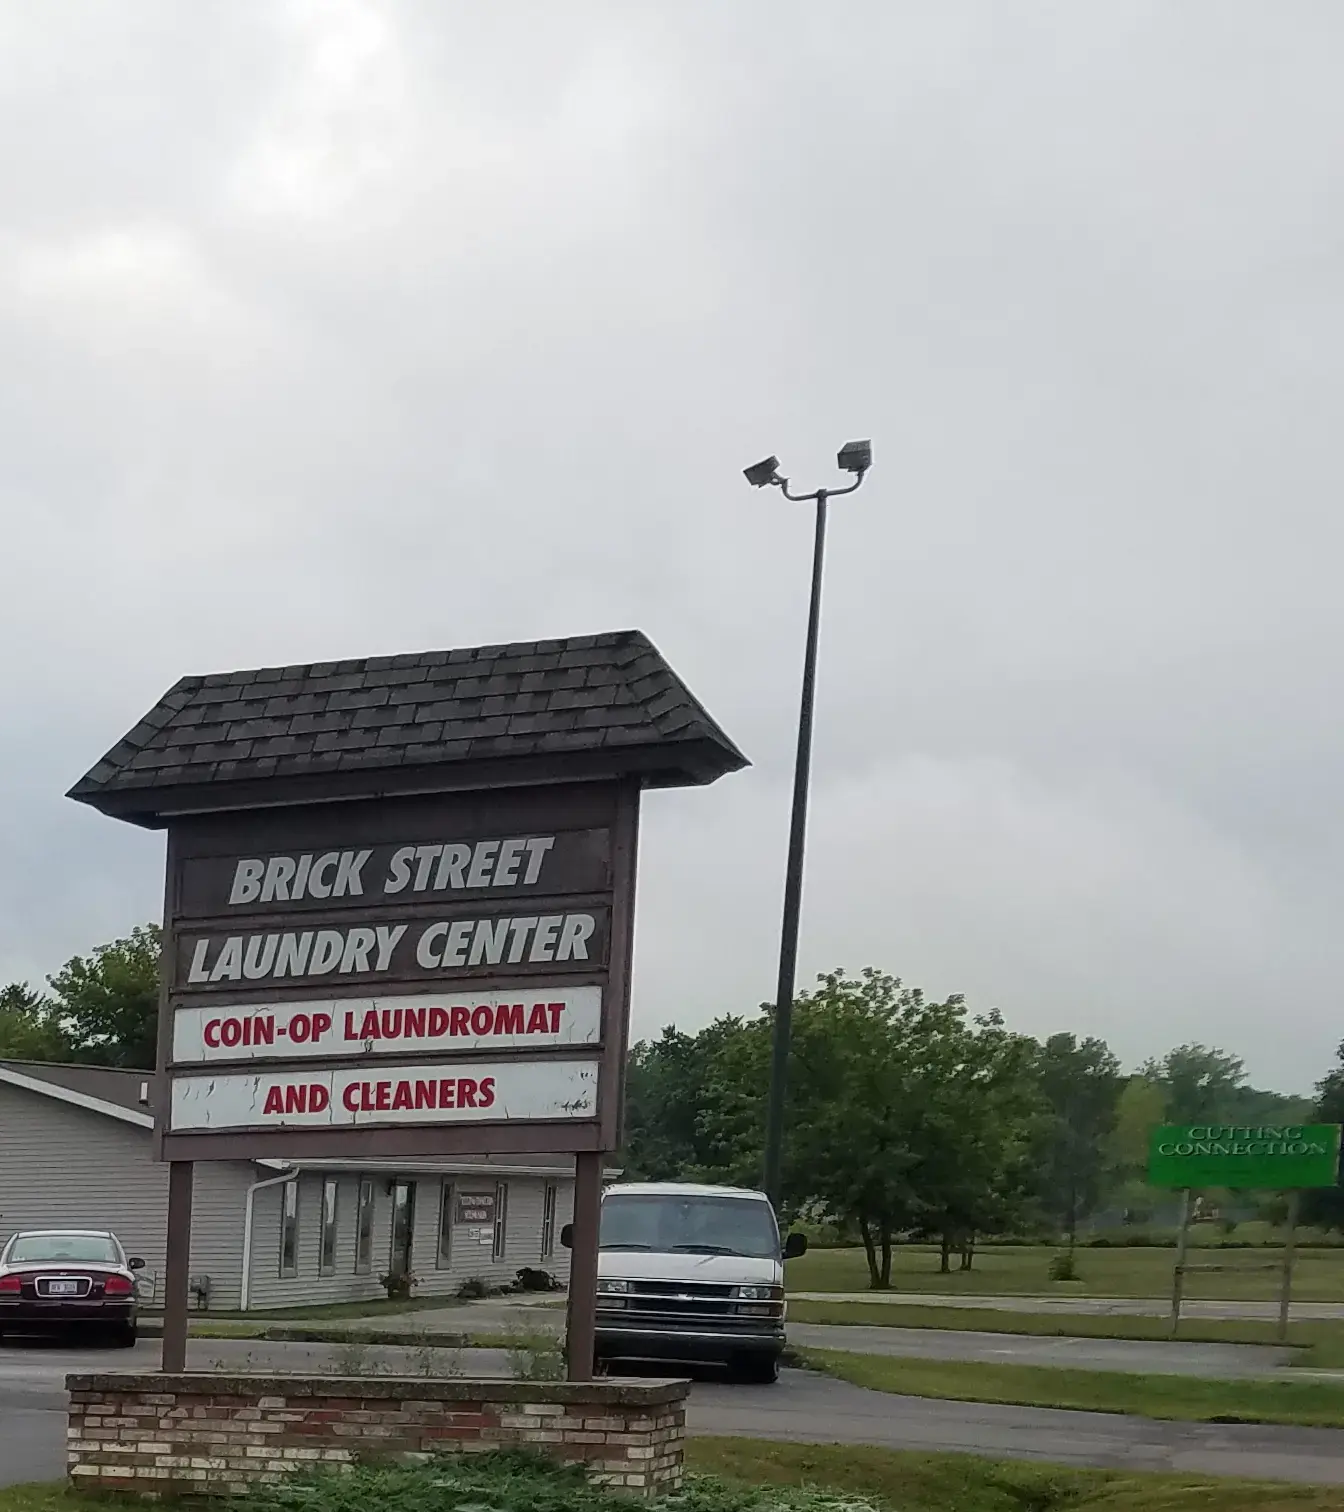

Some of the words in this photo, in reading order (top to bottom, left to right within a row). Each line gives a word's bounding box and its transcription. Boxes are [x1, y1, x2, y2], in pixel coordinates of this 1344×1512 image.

[228, 849, 374, 905] BRICK
[383, 836, 556, 893] STREET
[187, 925, 409, 984] LAUNDRY
[416, 914, 596, 969] CENTER
[203, 1013, 332, 1048] COIN-OP
[344, 1003, 566, 1041] LAUNDROMAT
[262, 1084, 330, 1115] AND
[342, 1077, 496, 1112] CLEANERS
[1158, 1141, 1328, 1156] CONNECTION
[1188, 1126, 1303, 1140] CUTTING
